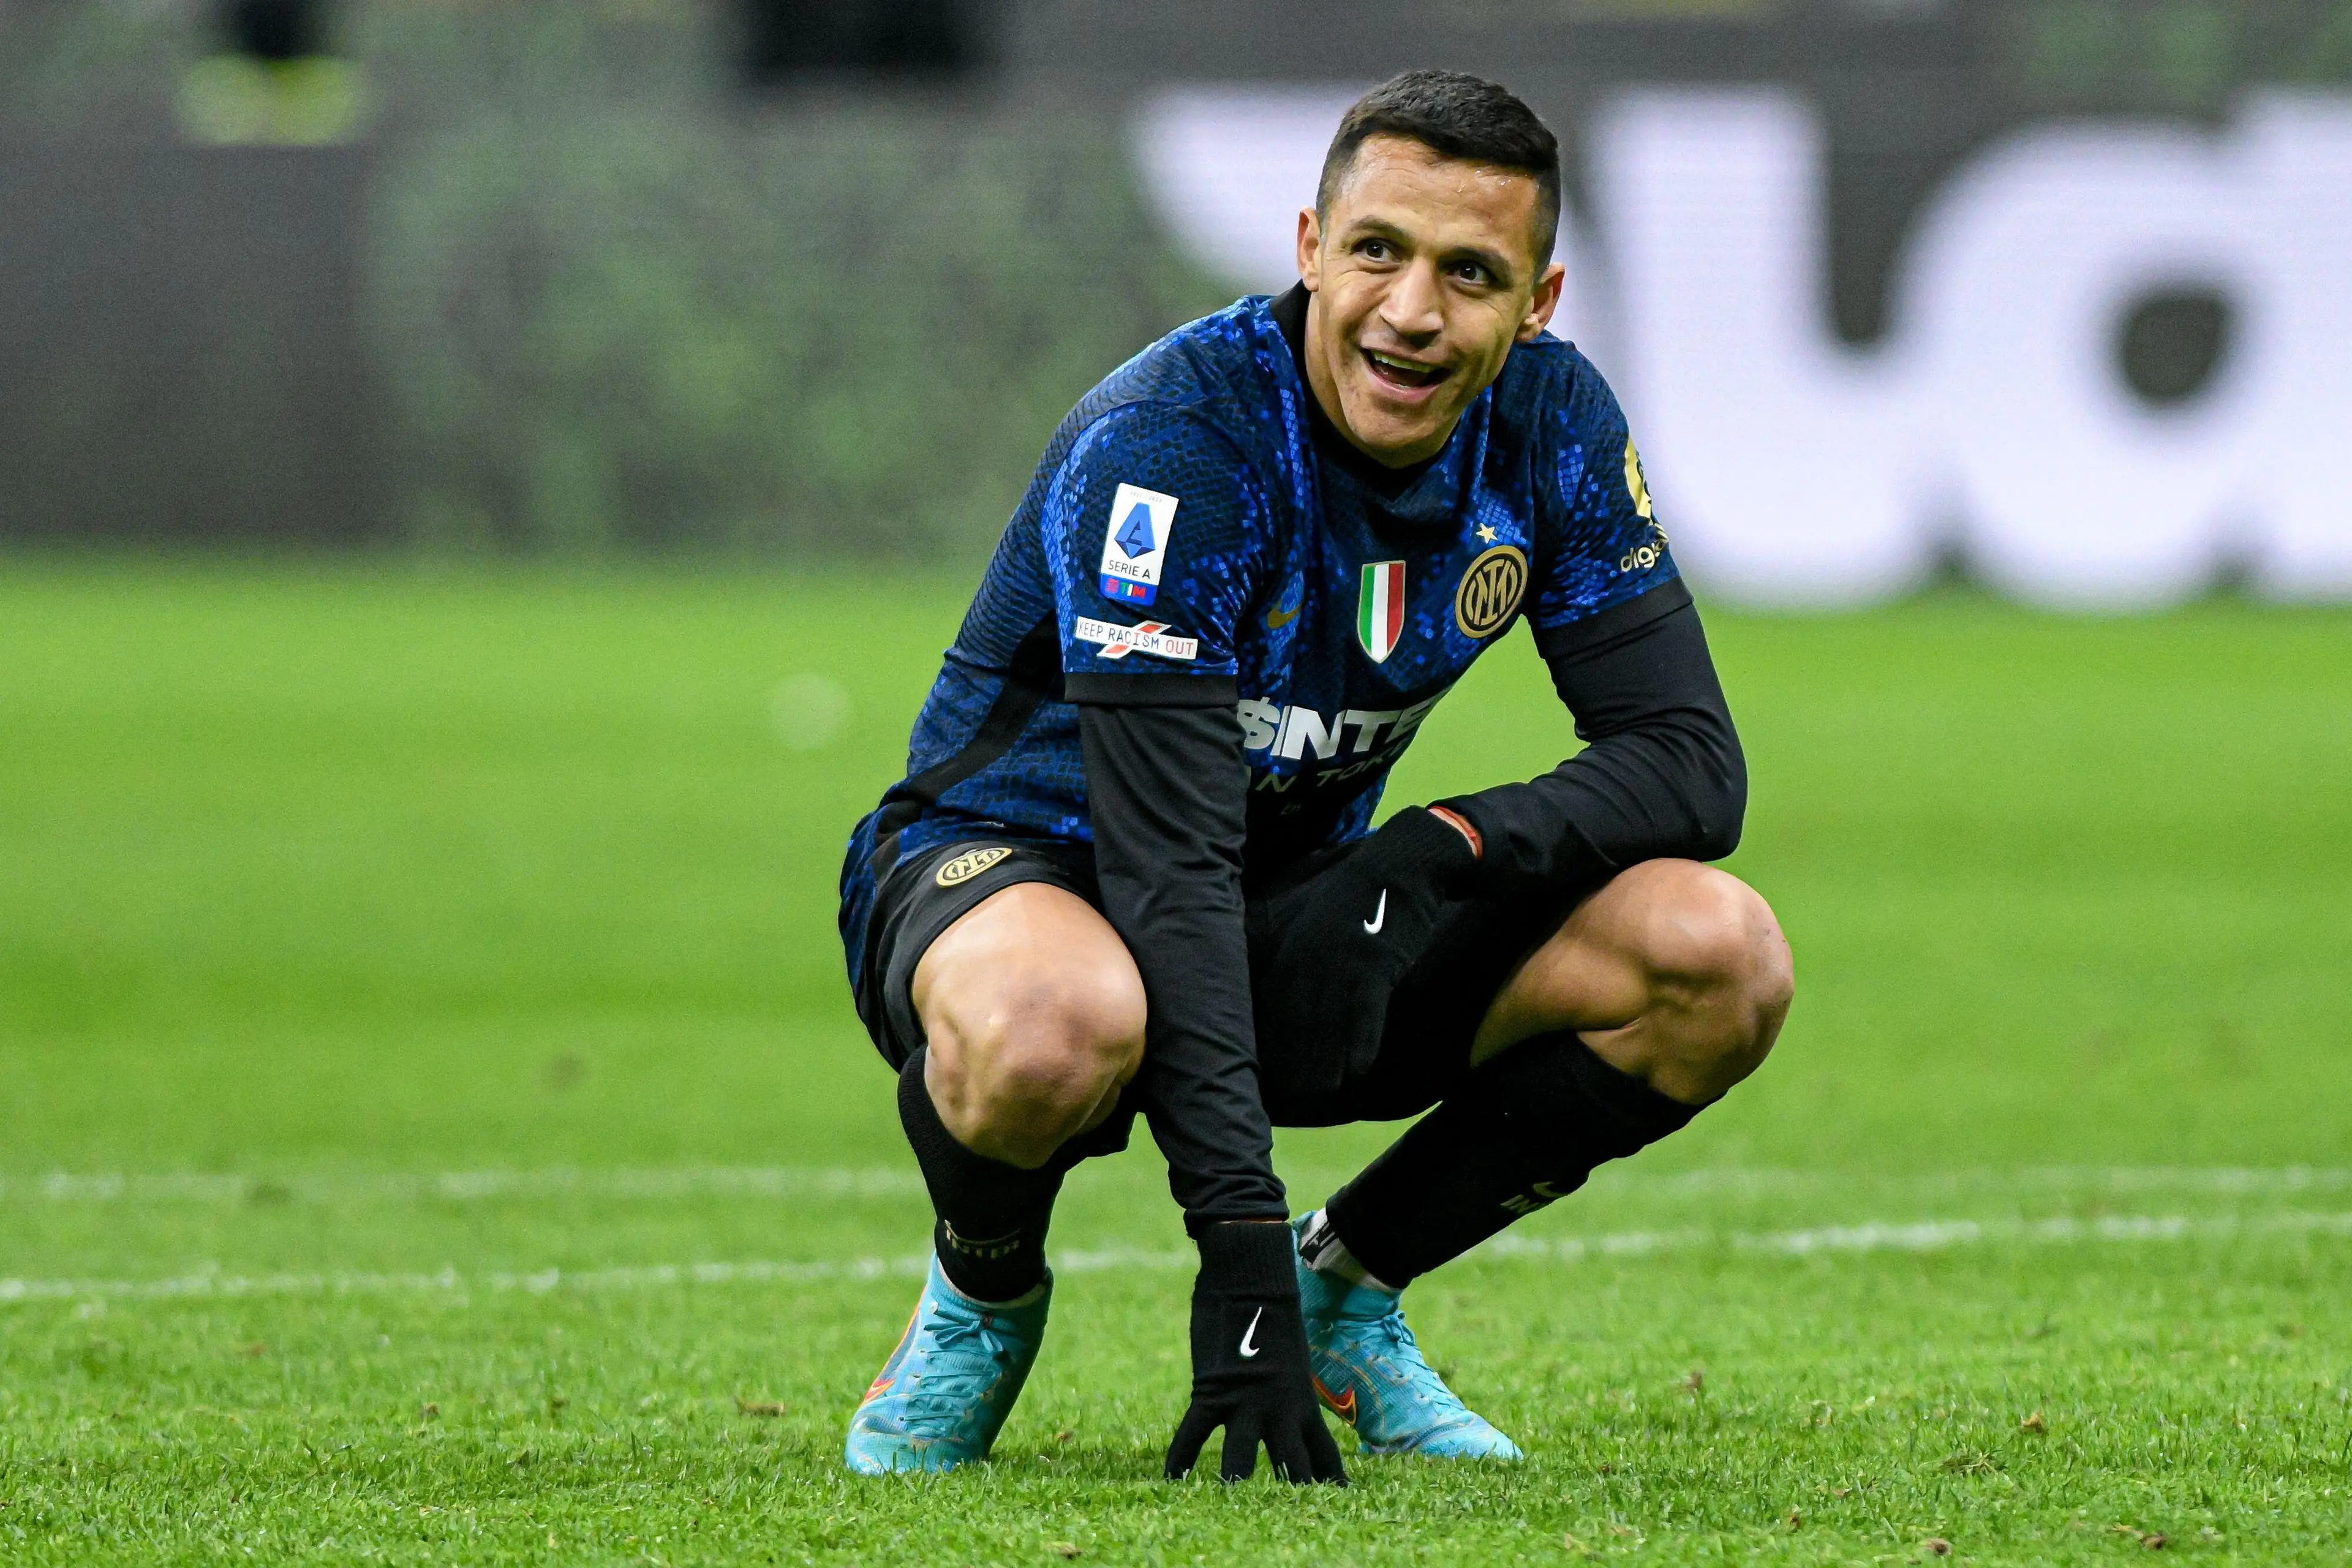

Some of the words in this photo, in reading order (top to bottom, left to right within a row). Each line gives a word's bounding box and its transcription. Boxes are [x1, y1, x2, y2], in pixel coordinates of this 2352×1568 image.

[1108, 559, 1139, 577] SERIE
[1142, 568, 1151, 579] A
[1120, 581, 1147, 599] TIM
[1078, 619, 1104, 638] KEEP
[1108, 628, 1159, 650] RACISM
[1165, 639, 1194, 656] OUT
